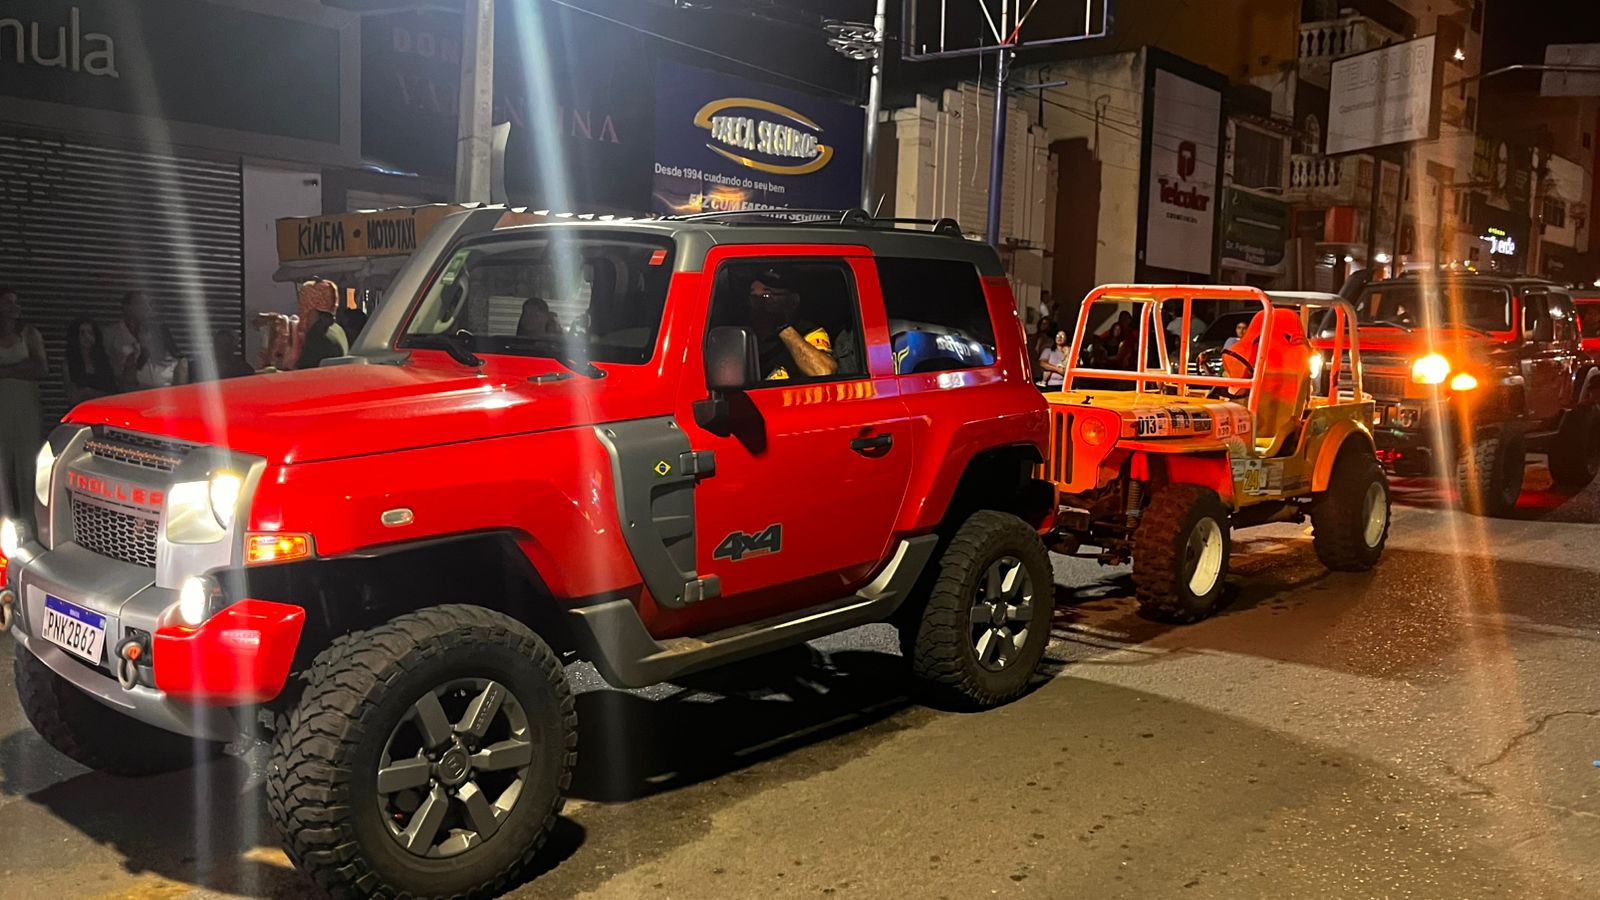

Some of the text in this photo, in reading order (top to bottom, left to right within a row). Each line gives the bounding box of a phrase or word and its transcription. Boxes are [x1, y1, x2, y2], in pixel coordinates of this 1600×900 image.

[757, 120, 819, 159] SEGUROS
[654, 163, 785, 194] Desde 1994 cuidando do seu bem
[1157, 178, 1210, 212] Telcolor
[68, 471, 165, 505] TROLLER
[1243, 469, 1260, 491] 24
[712, 522, 783, 562] 4x4
[47, 611, 96, 656] PNK2B62
